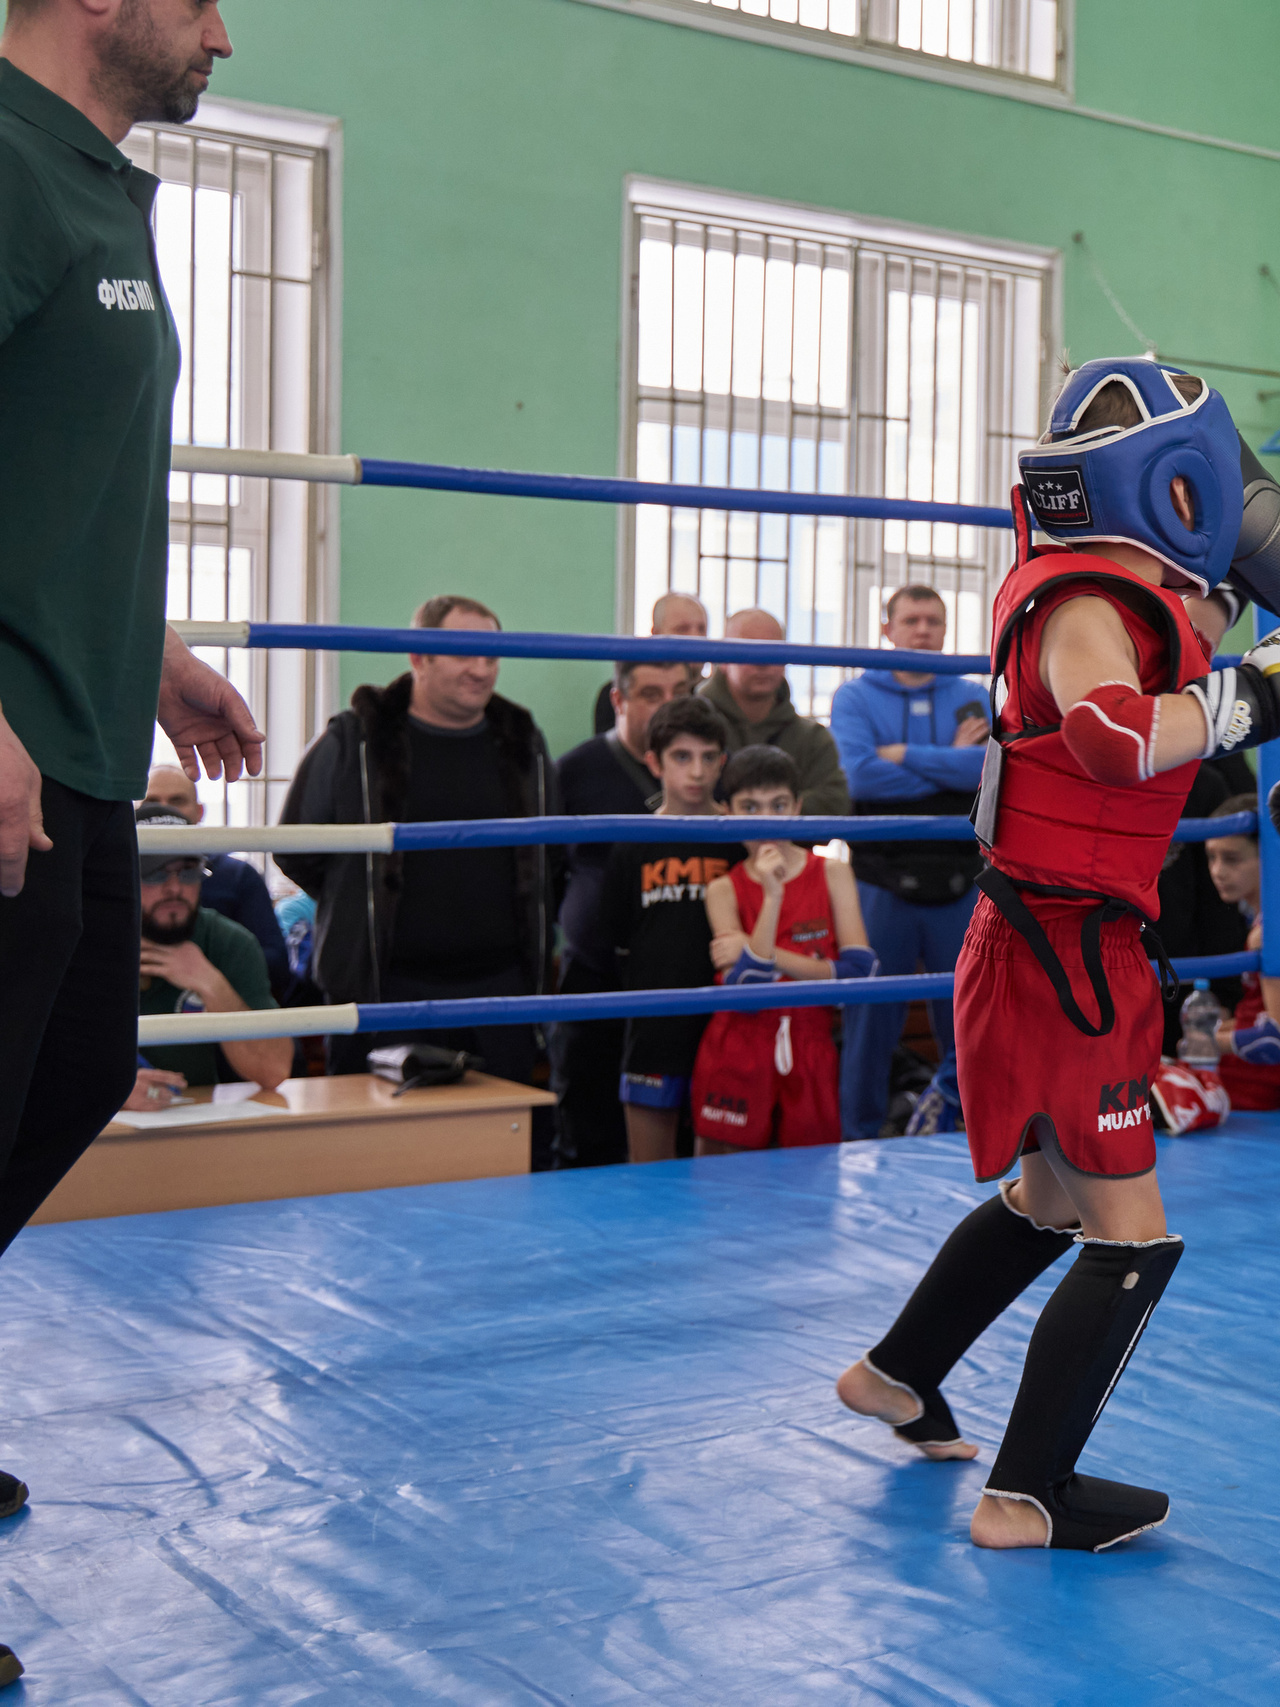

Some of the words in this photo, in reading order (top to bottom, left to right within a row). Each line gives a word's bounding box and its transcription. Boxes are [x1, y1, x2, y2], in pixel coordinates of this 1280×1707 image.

[98, 279, 155, 310] ФКБМО
[1032, 489, 1081, 510] CLIFF
[1098, 1106, 1143, 1132] MUAY
